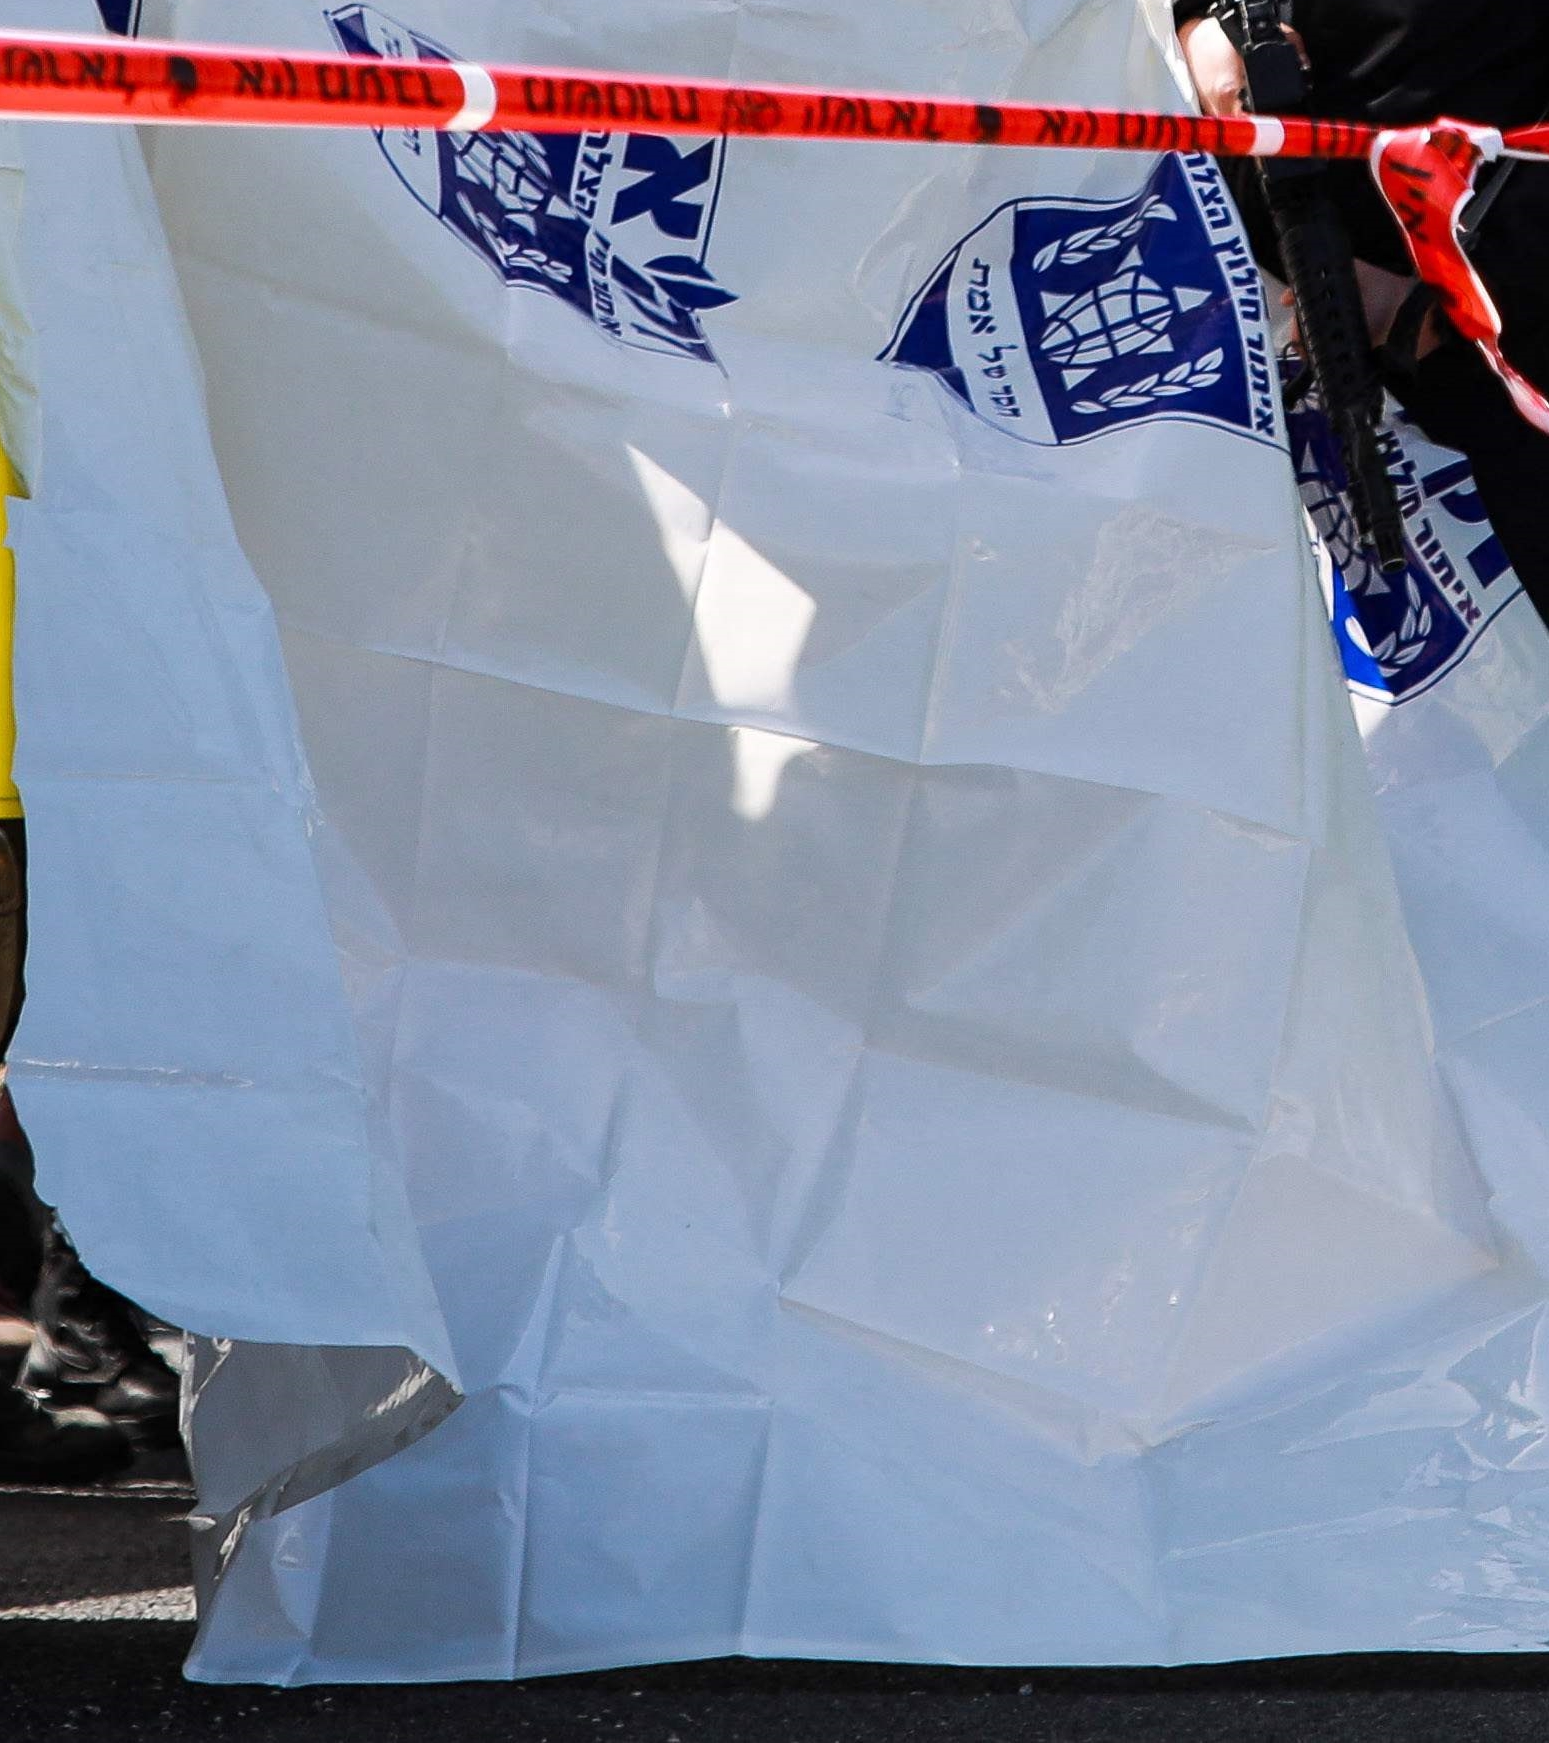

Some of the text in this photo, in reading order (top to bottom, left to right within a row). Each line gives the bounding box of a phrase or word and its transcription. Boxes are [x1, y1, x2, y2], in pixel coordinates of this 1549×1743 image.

[231, 57, 299, 99] אין
[316, 62, 445, 109] מעבר
[523, 77, 702, 123] משטרת
[965, 257, 997, 336] אמת
[1216, 234, 1264, 324] חילוץ
[977, 342, 1020, 384] של
[1246, 331, 1276, 438] איתור
[1415, 516, 1482, 625] איתור
